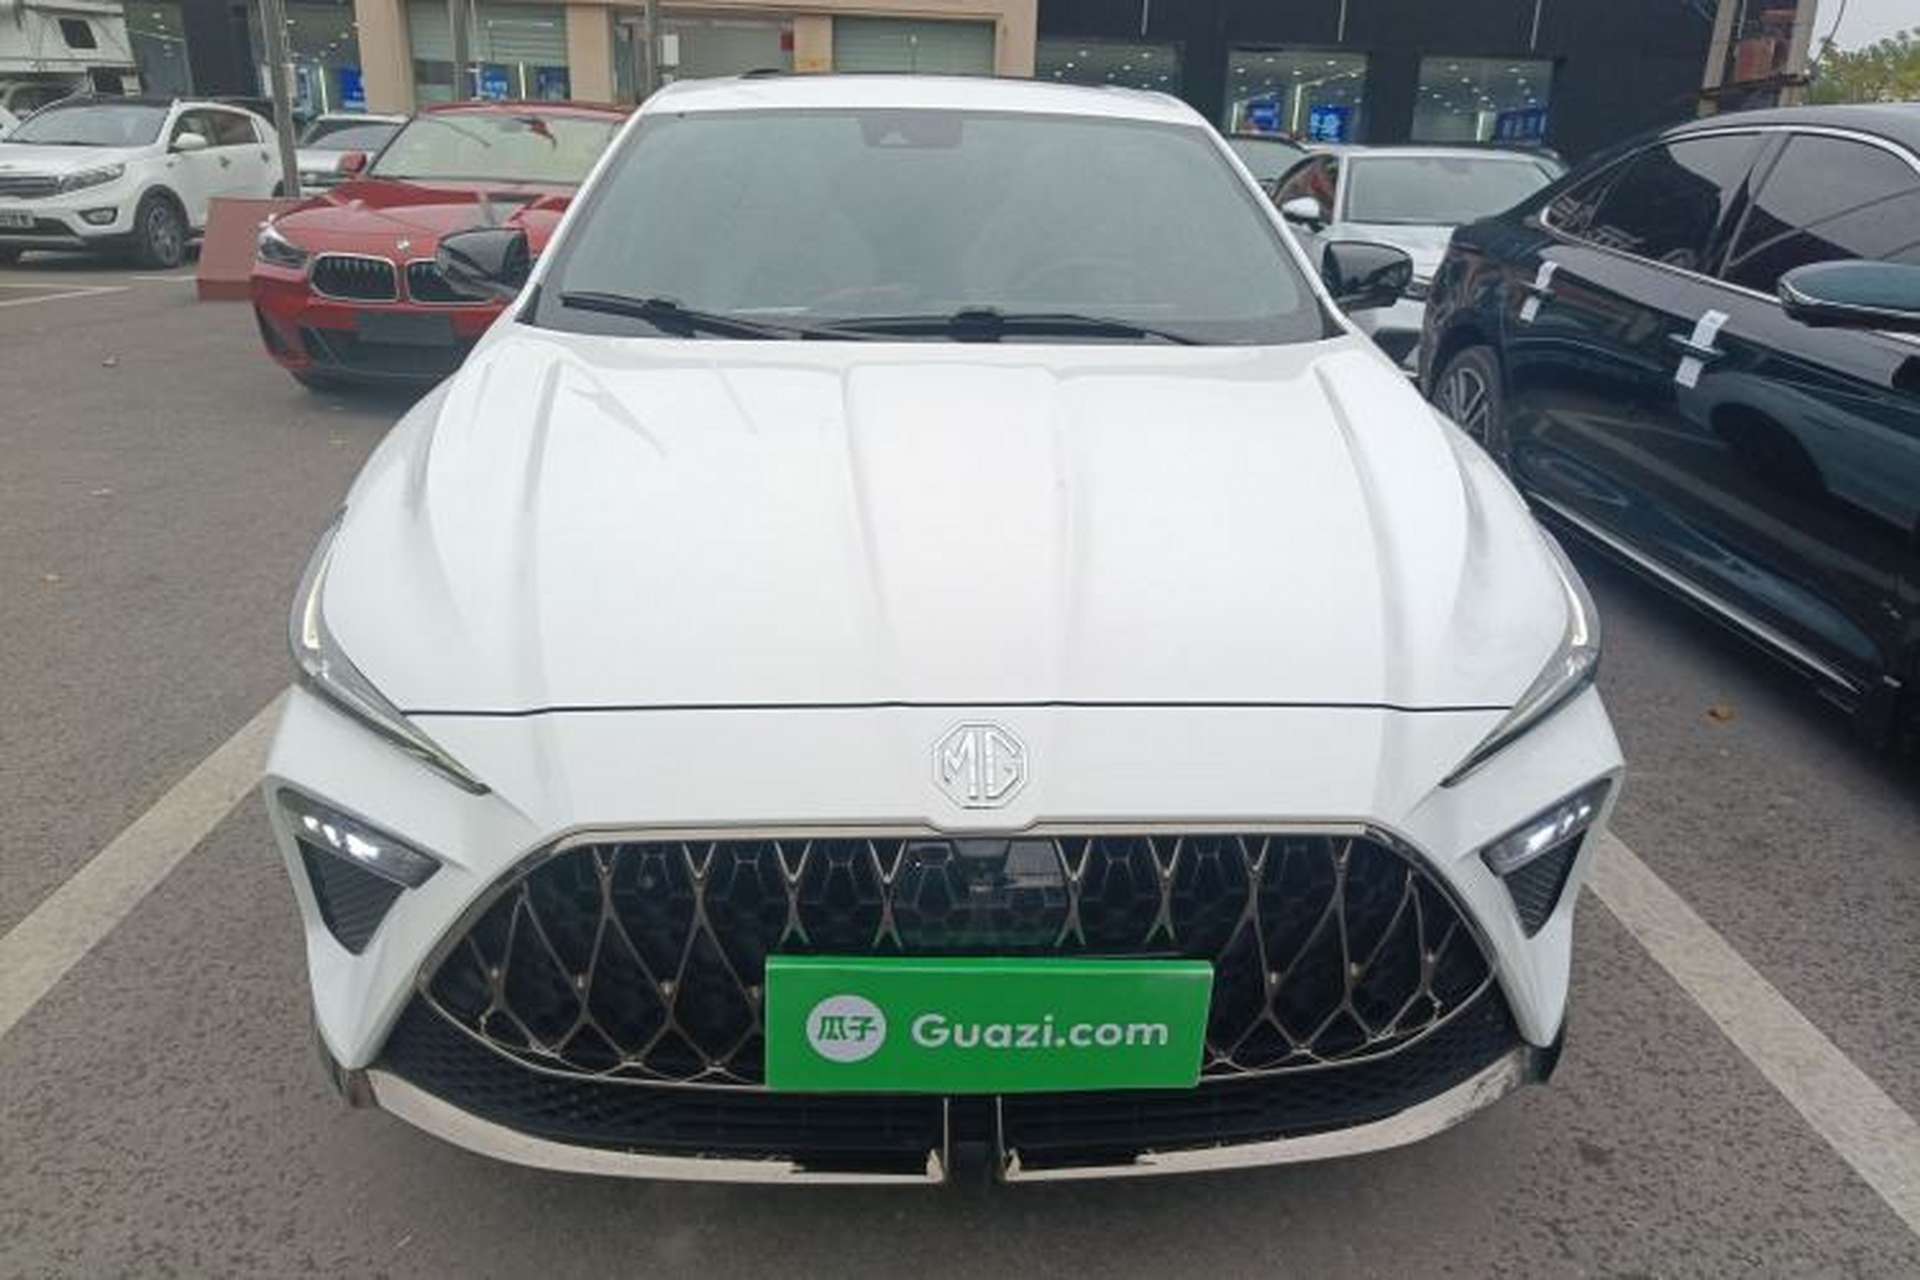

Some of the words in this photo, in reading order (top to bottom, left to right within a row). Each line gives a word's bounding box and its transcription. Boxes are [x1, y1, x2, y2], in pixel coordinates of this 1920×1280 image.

[942, 730, 1020, 800] MG
[817, 1016, 877, 1041] 瓜子
[911, 1013, 1169, 1048] Guazi.com
